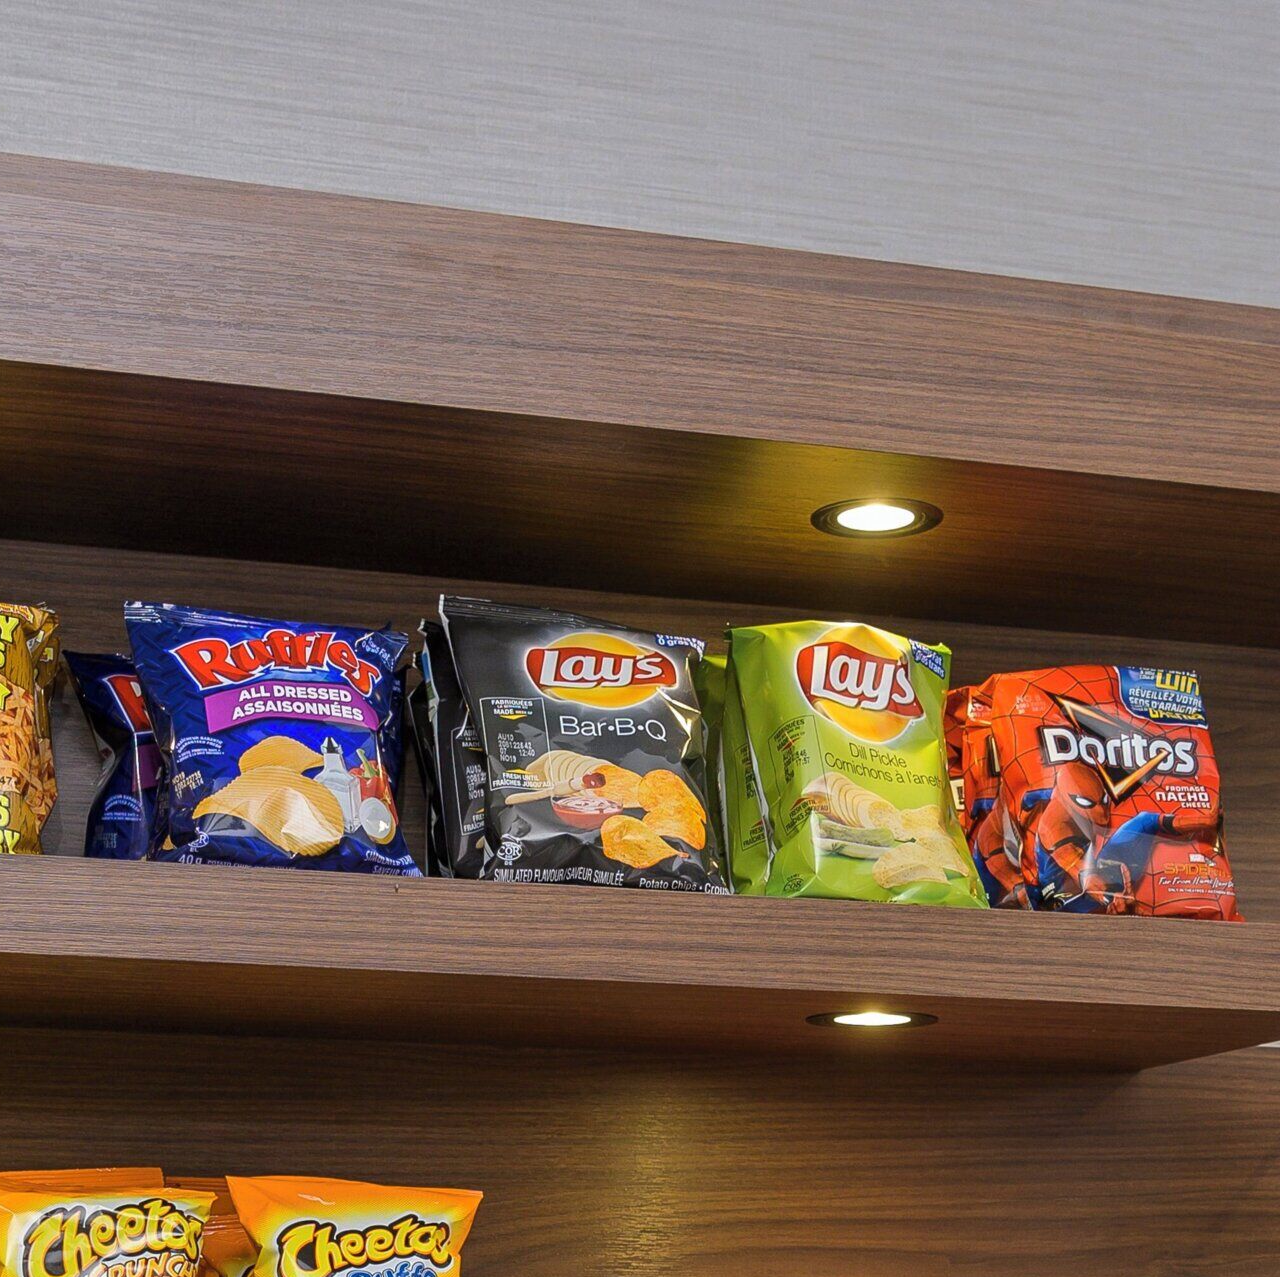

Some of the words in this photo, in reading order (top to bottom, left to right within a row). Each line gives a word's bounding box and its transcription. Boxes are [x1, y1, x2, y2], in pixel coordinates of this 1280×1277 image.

[169, 628, 384, 698] Ruffles
[539, 649, 666, 690] Lay's
[810, 645, 916, 711] Lay's
[238, 688, 270, 701] ALL
[273, 685, 352, 703] DRESSED
[1128, 687, 1174, 703] RÉVEILLEZ
[231, 700, 365, 722] ASSAISONNÉES
[849, 743, 867, 761] Dill
[870, 748, 907, 768] Pickle
[1042, 727, 1197, 776] Doritos
[825, 753, 893, 783] Cornichons
[896, 769, 905, 785] à
[1155, 791, 1210, 802] NACHO
[494, 869, 533, 882] SIMULATED
[593, 870, 624, 886] SIMULÉE
[639, 878, 668, 890] Potato
[671, 880, 697, 892] Chips
